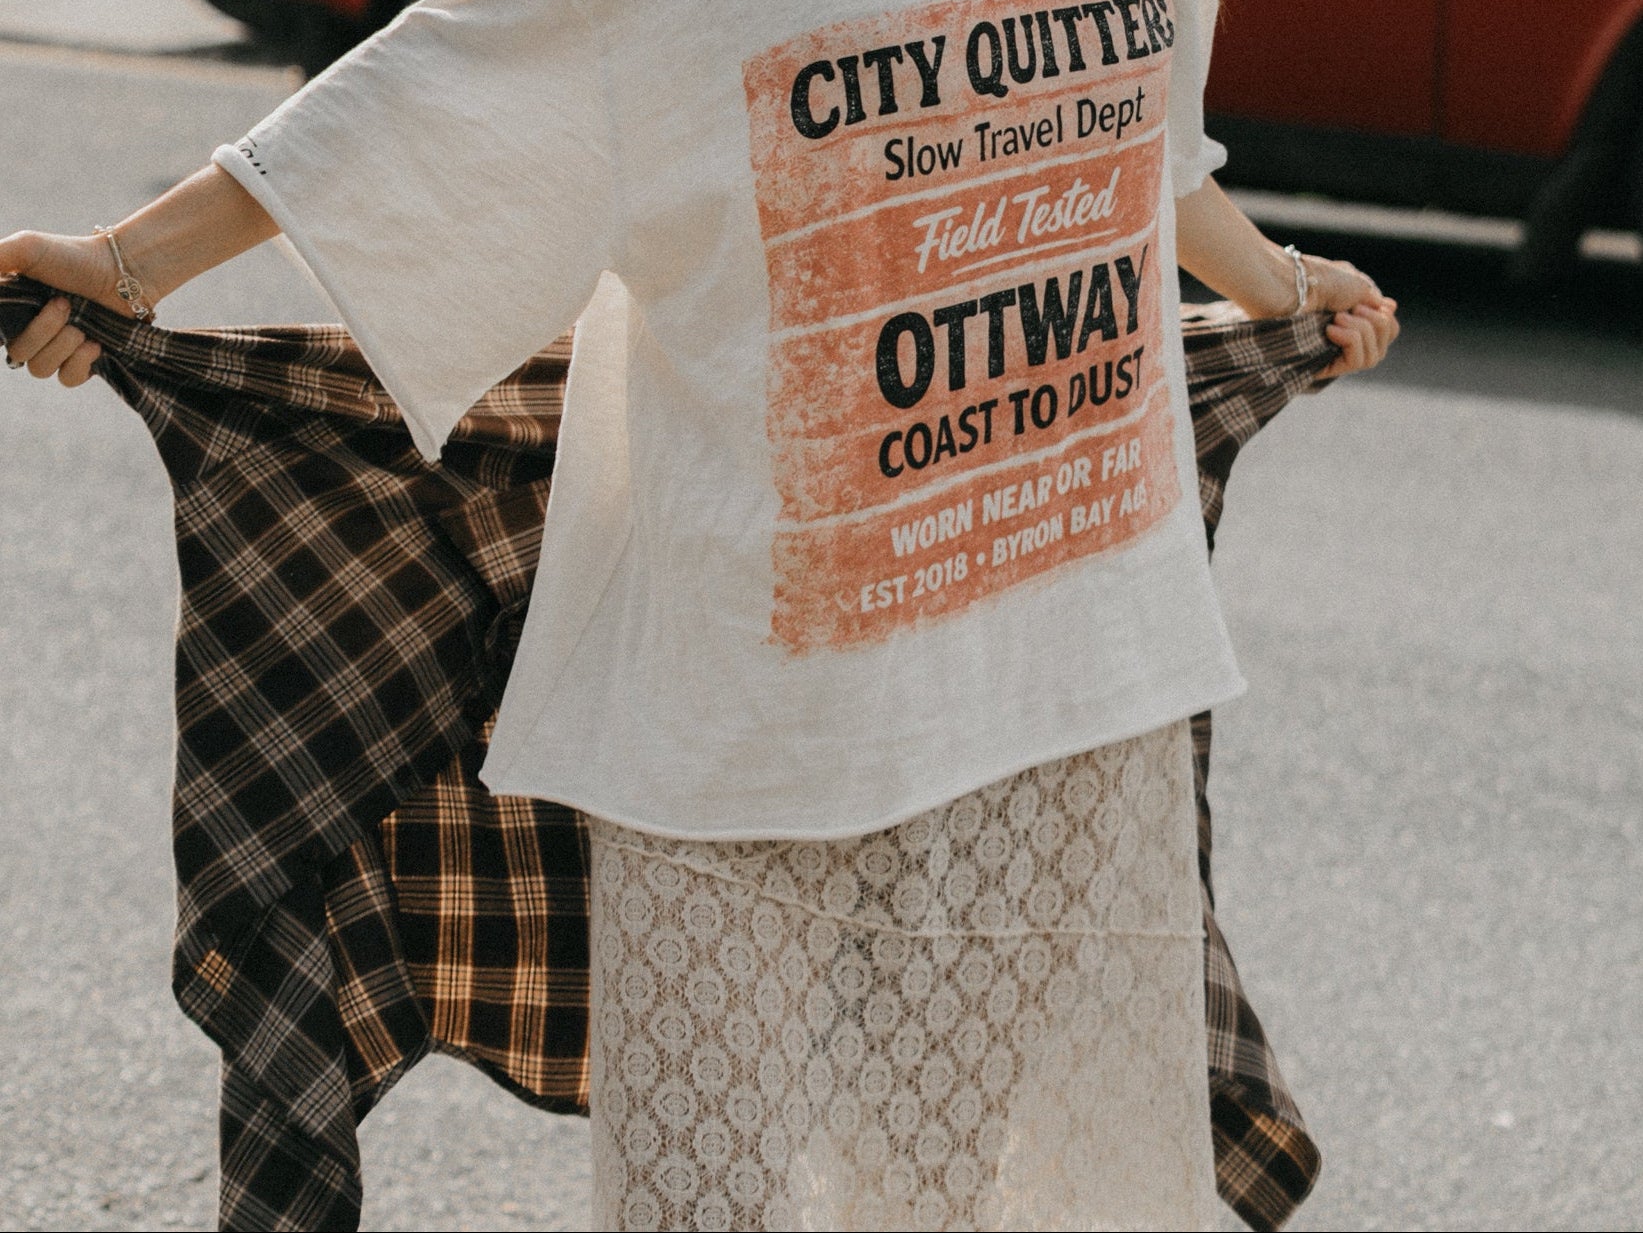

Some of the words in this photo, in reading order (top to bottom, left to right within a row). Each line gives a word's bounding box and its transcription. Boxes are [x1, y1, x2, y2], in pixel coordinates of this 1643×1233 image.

[790, 36, 946, 140] CITY
[884, 138, 964, 181] Slow
[974, 105, 1063, 163] Travel
[1078, 86, 1146, 140] Dept
[914, 194, 1006, 274] Field
[1013, 168, 1119, 244] Tested
[876, 244, 1149, 409] OTTWAY
[878, 398, 999, 478] COAST
[1008, 384, 1058, 435] TO
[1068, 346, 1145, 418] DUST
[859, 574, 909, 613] EST
[911, 556, 969, 600] 2018
[991, 515, 1064, 568] BYRON
[1069, 496, 1116, 531] BAY
[890, 498, 974, 558] WORN
[982, 476, 1055, 526] NEAR
[1056, 453, 1091, 496] OR
[1101, 437, 1143, 483] FAR
